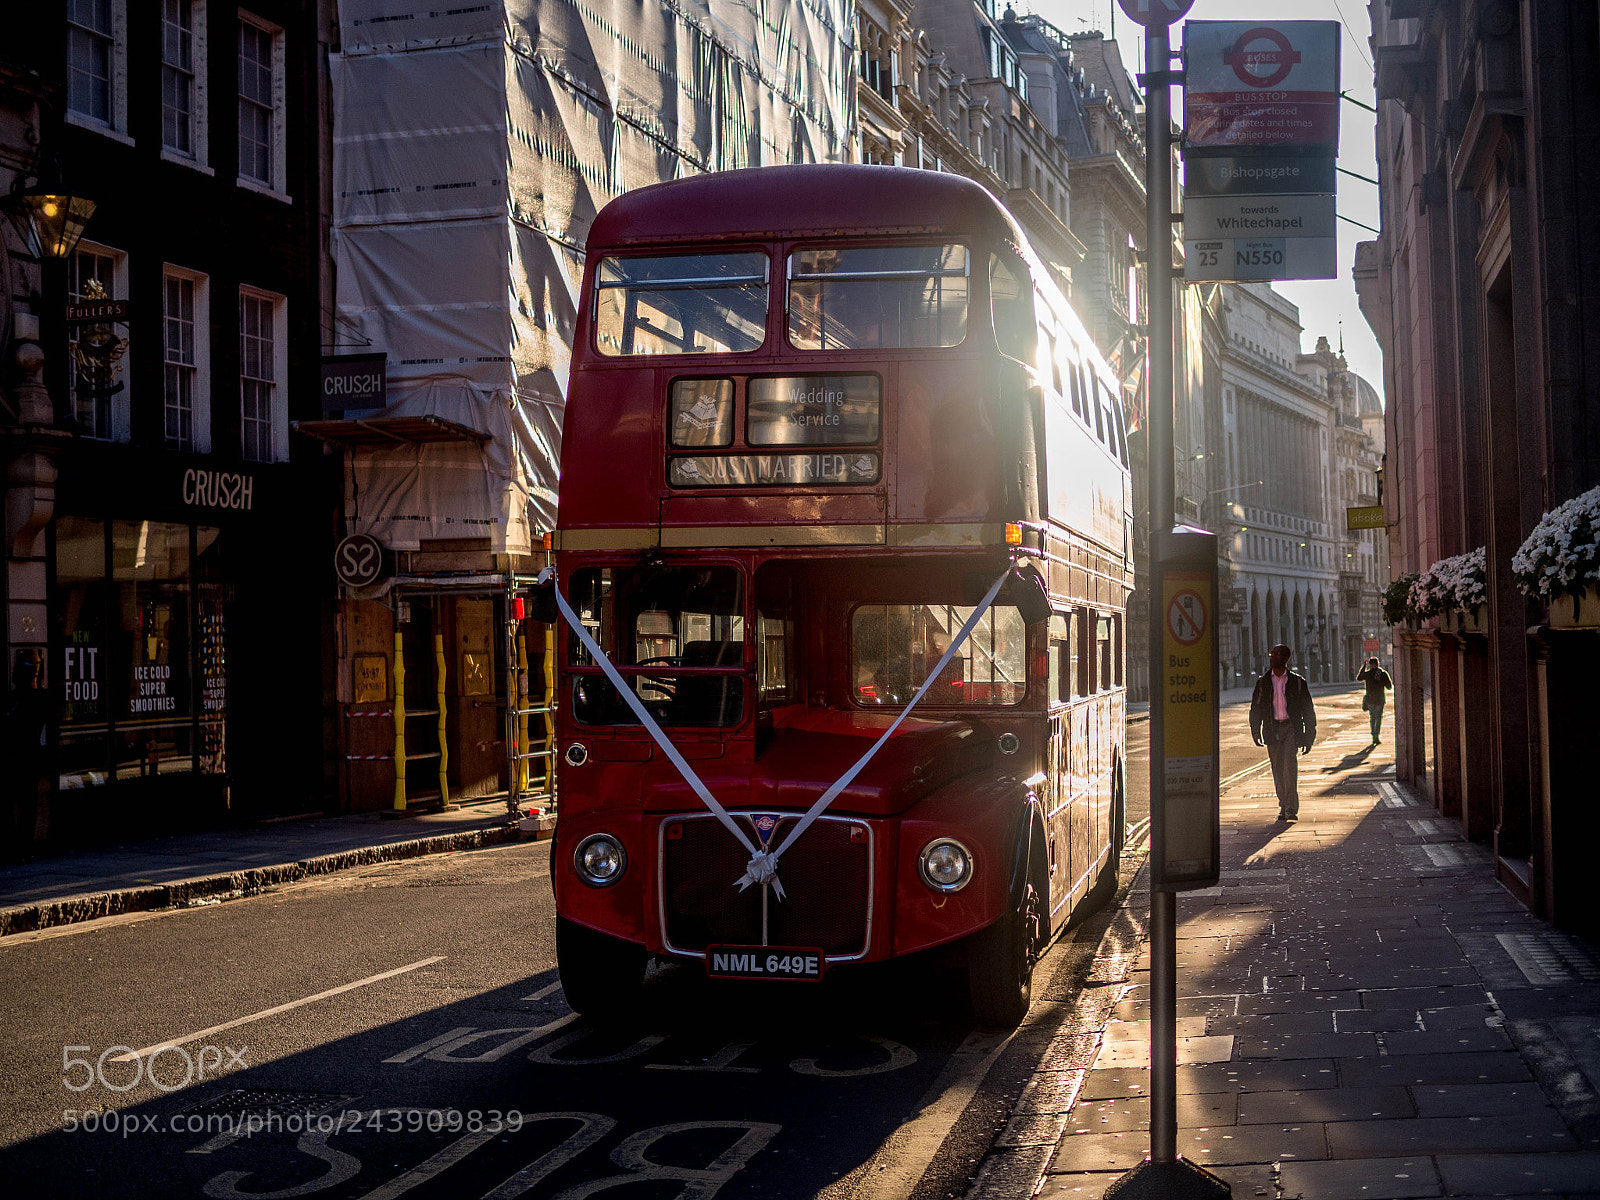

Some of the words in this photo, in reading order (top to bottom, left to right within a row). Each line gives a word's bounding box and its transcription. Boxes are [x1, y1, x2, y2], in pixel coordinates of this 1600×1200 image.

[1248, 53, 1277, 62] BUSES
[1234, 93, 1257, 101] BUS
[1258, 92, 1288, 101] STOP
[1223, 107, 1240, 116] Bus
[1266, 106, 1298, 116] closed
[1239, 119, 1265, 128] dates
[1267, 119, 1284, 128] and
[1286, 118, 1313, 128] times
[1225, 130, 1263, 140] detailed
[1265, 130, 1294, 139] below
[1220, 165, 1300, 179] Bishopsgate
[1240, 205, 1280, 214] towards
[1217, 216, 1303, 230] Whitechapel
[1199, 251, 1218, 266] 25
[1236, 250, 1283, 265] N550
[324, 373, 381, 395] CRUSSH
[788, 387, 844, 407] Wedding
[790, 411, 840, 427] Service
[706, 455, 751, 479] JUST
[758, 455, 845, 478] MARRIED
[182, 468, 253, 510] CRUSSH
[72, 631, 90, 643] NEW
[64, 647, 98, 680] FIT
[1169, 655, 1190, 667] Bus
[134, 666, 149, 680] ICE
[150, 665, 171, 680] COLD
[1169, 673, 1196, 687] stop
[65, 681, 99, 701] FOOD
[139, 681, 166, 696] SUPER
[1169, 689, 1207, 703] closed
[130, 696, 176, 713] SMOOTHIES
[713, 953, 763, 972] NML
[766, 956, 819, 975] 649E
